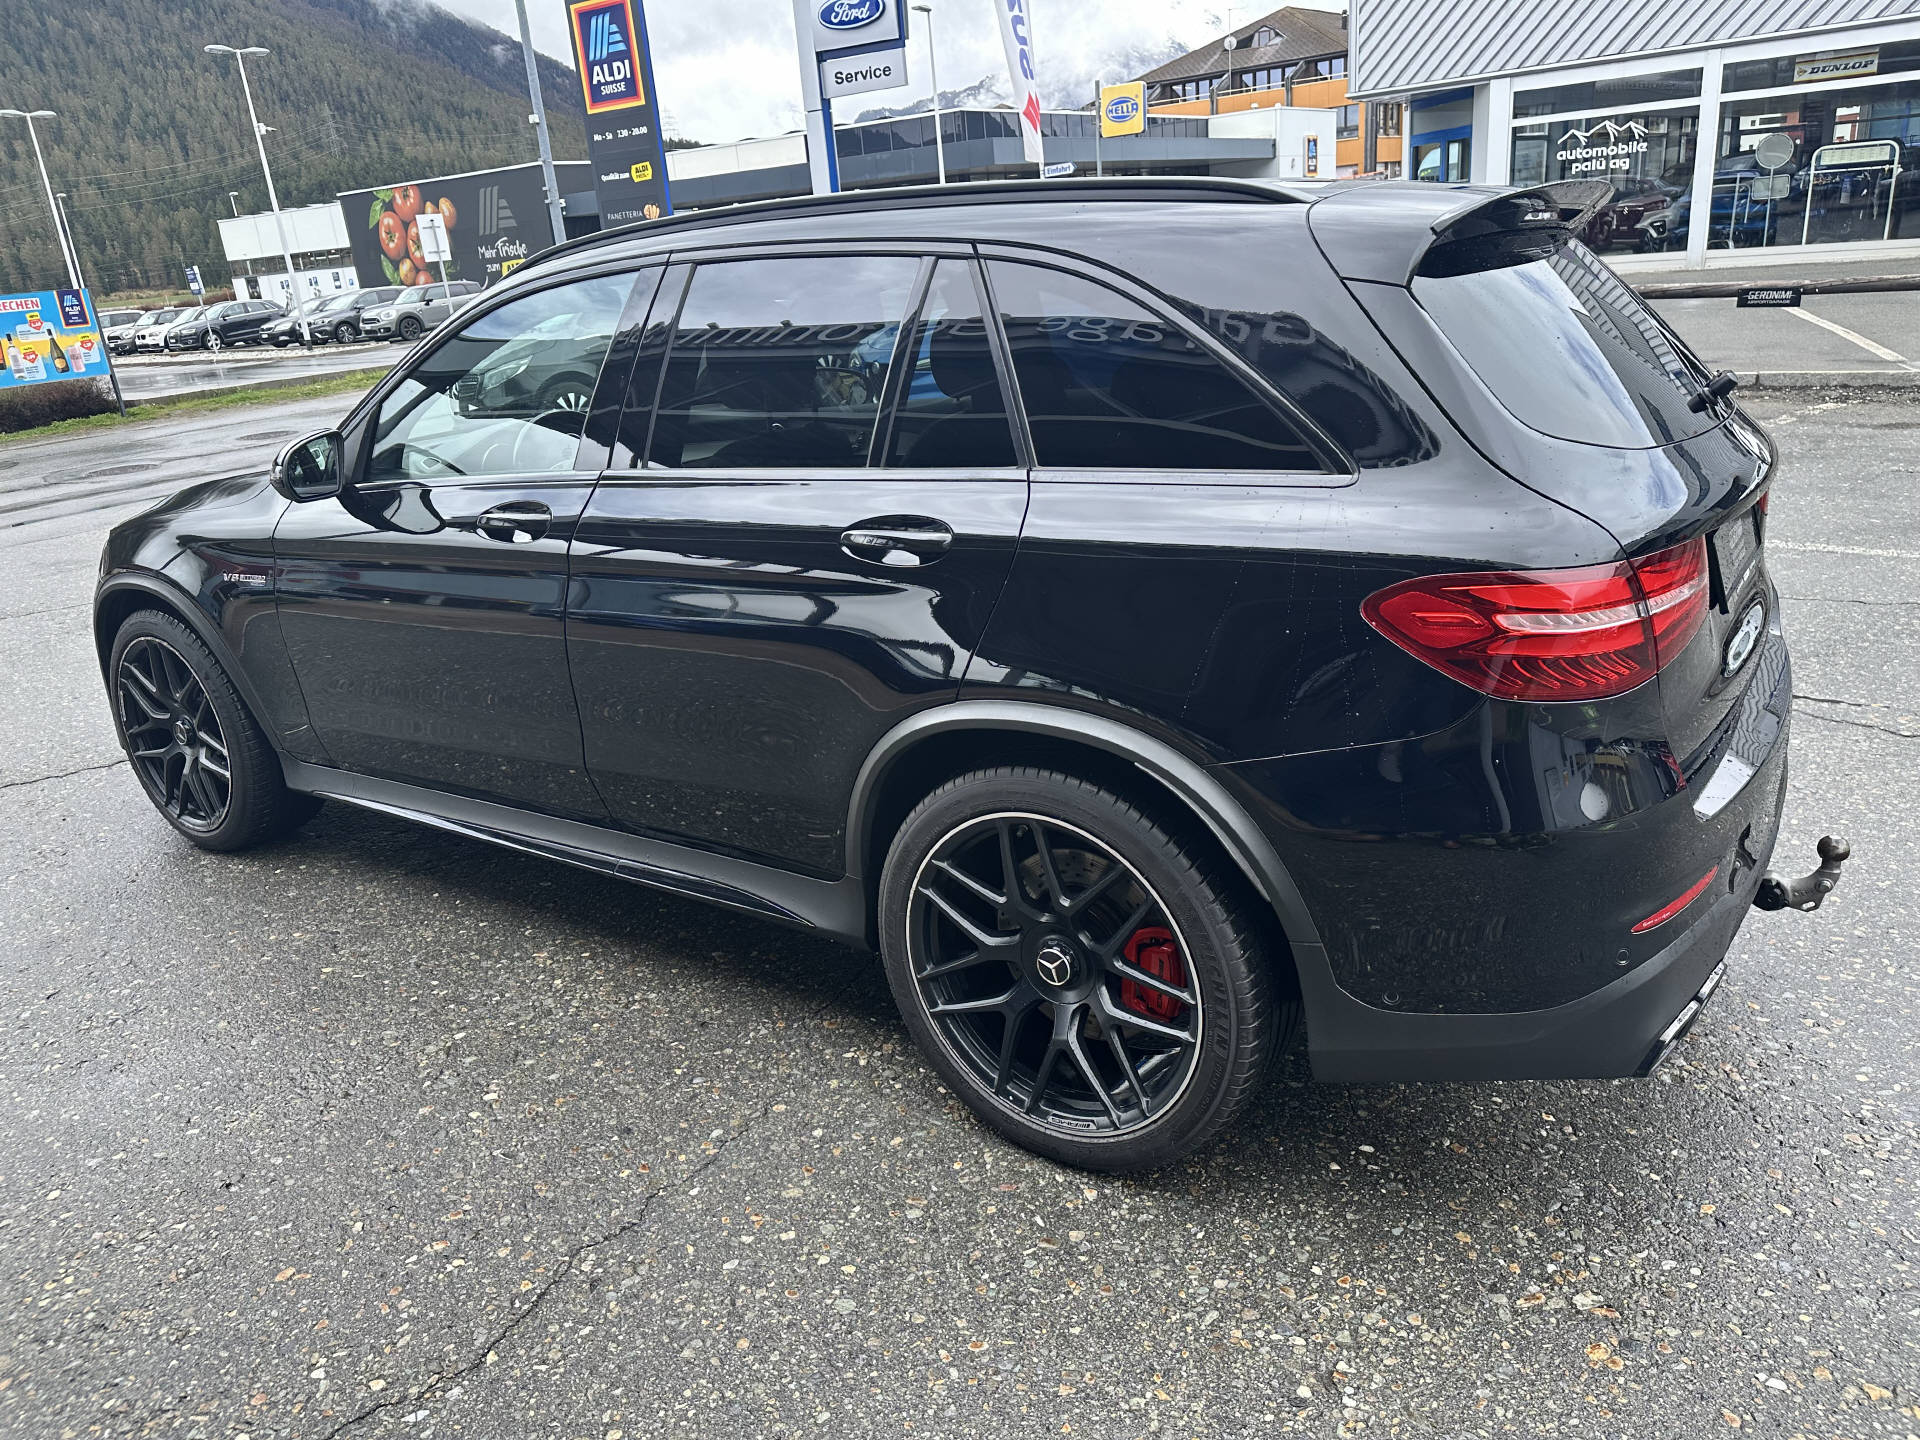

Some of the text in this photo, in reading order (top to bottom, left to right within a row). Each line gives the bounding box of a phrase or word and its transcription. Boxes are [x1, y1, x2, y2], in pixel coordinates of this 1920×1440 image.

[831, 0, 870, 23] Ford
[593, 59, 631, 85] ALDI
[1808, 59, 1875, 74] DUNLOP
[834, 65, 891, 85] Service
[600, 82, 626, 95] SUISSE
[1108, 101, 1139, 115] HELLA
[1556, 141, 1648, 160] automobile
[635, 164, 649, 173] ALDI
[1047, 165, 1071, 175] Einfahrt
[1571, 158, 1630, 174] palü ag
[607, 210, 643, 219] PANETTERIA
[478, 237, 527, 259] Mehr Frische
[486, 263, 500, 272] zum
[1748, 290, 1792, 300] GERONIMI
[223, 573, 239, 581] V8
